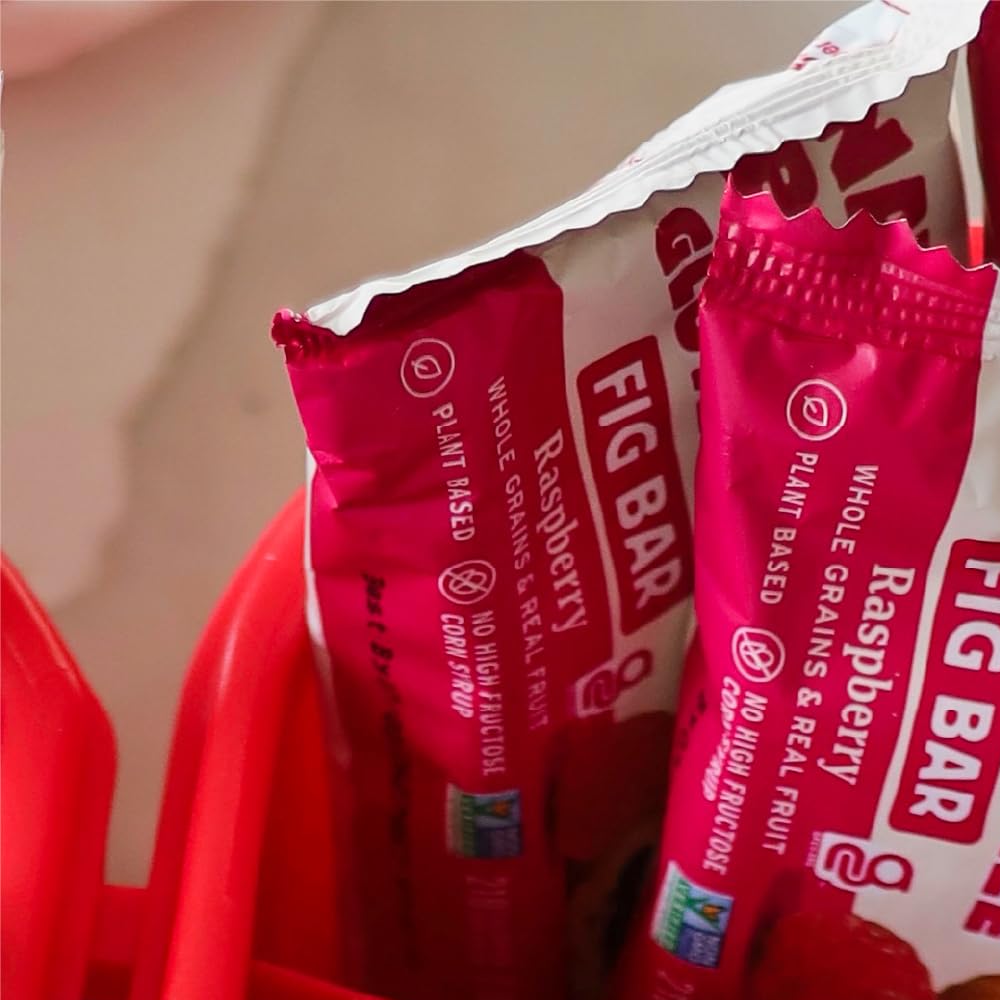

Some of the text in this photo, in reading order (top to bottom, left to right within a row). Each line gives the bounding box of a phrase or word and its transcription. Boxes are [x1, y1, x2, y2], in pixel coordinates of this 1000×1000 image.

[432, 402, 475, 541] PLANT BASED
[487, 376, 516, 471] WHOLE
[593, 359, 682, 609] FIG BAR
[505, 475, 531, 571] GRAINS
[534, 428, 589, 634] Raspberry
[760, 452, 818, 604] PLANT BASED
[440, 613, 468, 658] CORN
[471, 610, 506, 776] NO HIGH FRUCTOSE
[520, 598, 544, 664] REAL
[527, 666, 549, 730] FRUIT
[762, 465, 878, 855] WHOLE GRAINS & REAL FRUIT
[817, 564, 916, 785] Raspberry
[703, 691, 768, 875] NO HIGH FRUCTOSE
[909, 695, 995, 823] BAR
